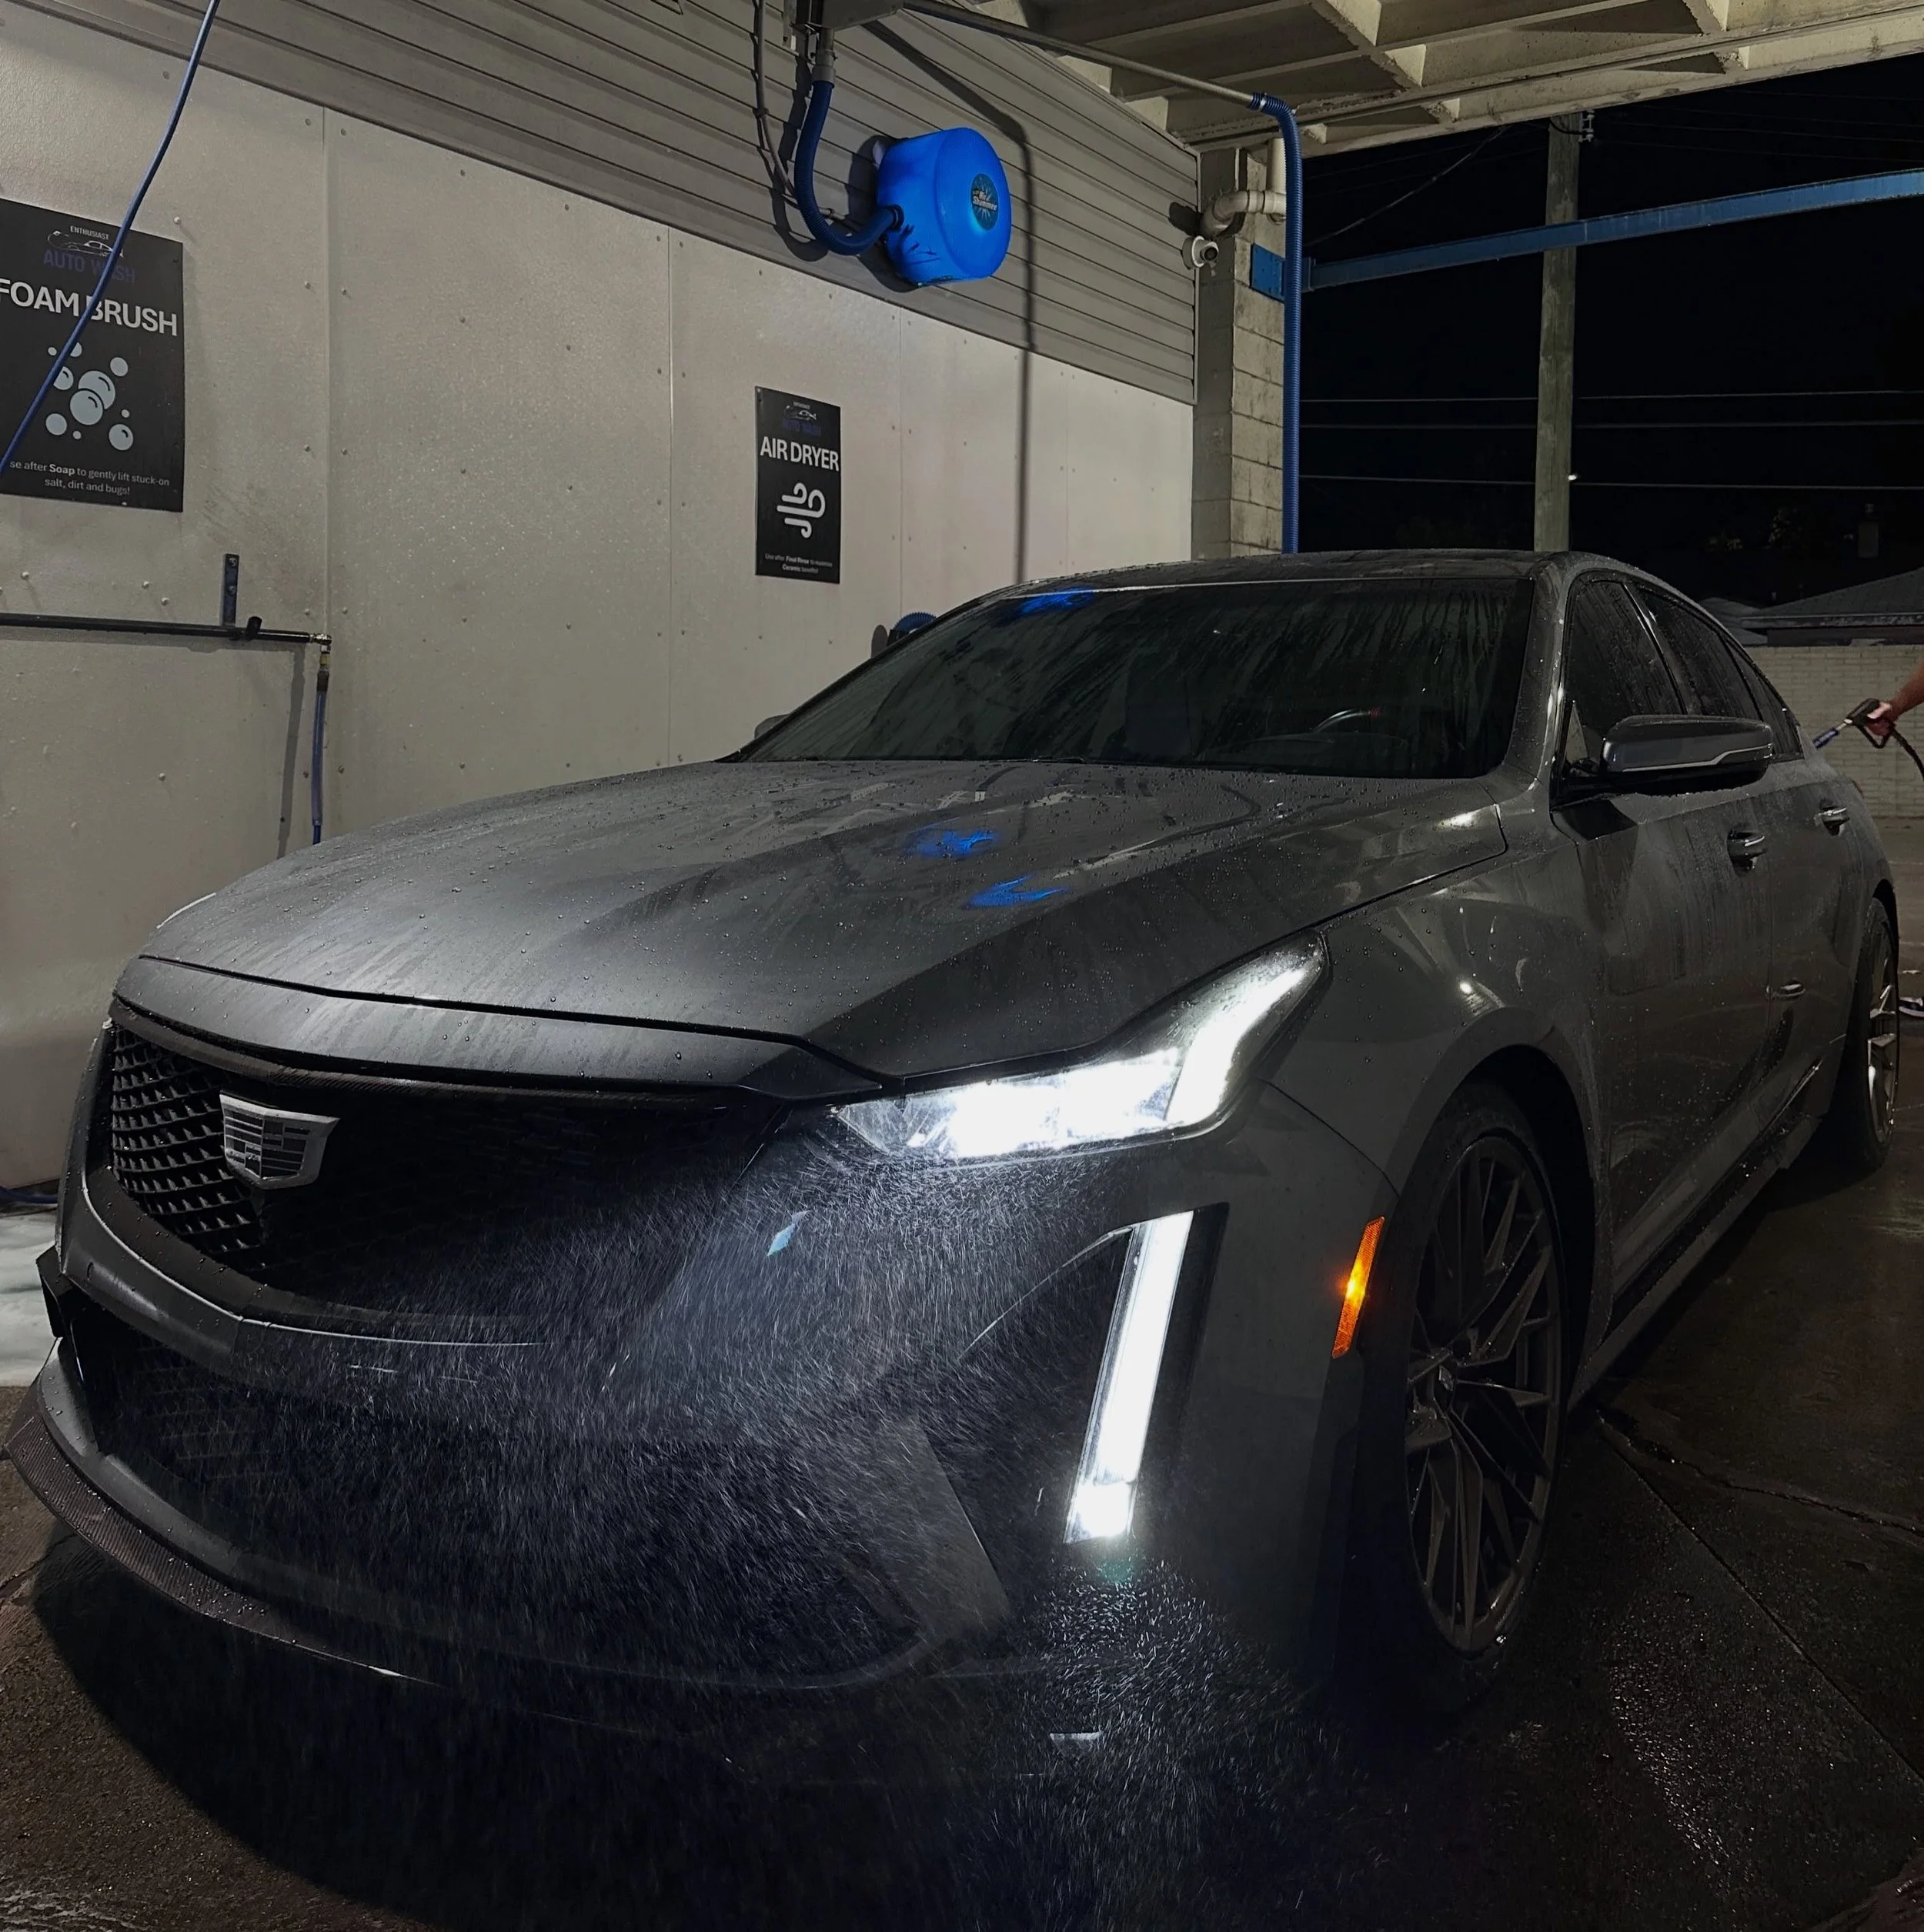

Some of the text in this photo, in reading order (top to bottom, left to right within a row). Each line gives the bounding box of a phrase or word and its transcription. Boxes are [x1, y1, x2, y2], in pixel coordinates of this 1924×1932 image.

[69, 225, 109, 240] ENTHUSIAST
[43, 249, 136, 284] AUTO WSH
[0, 278, 79, 317] FOAM
[760, 435, 840, 472] AIR DRYER
[9, 460, 170, 486] se after Soap to gently lift stuck-on
[44, 478, 130, 496] salt, dirt and bugs!
